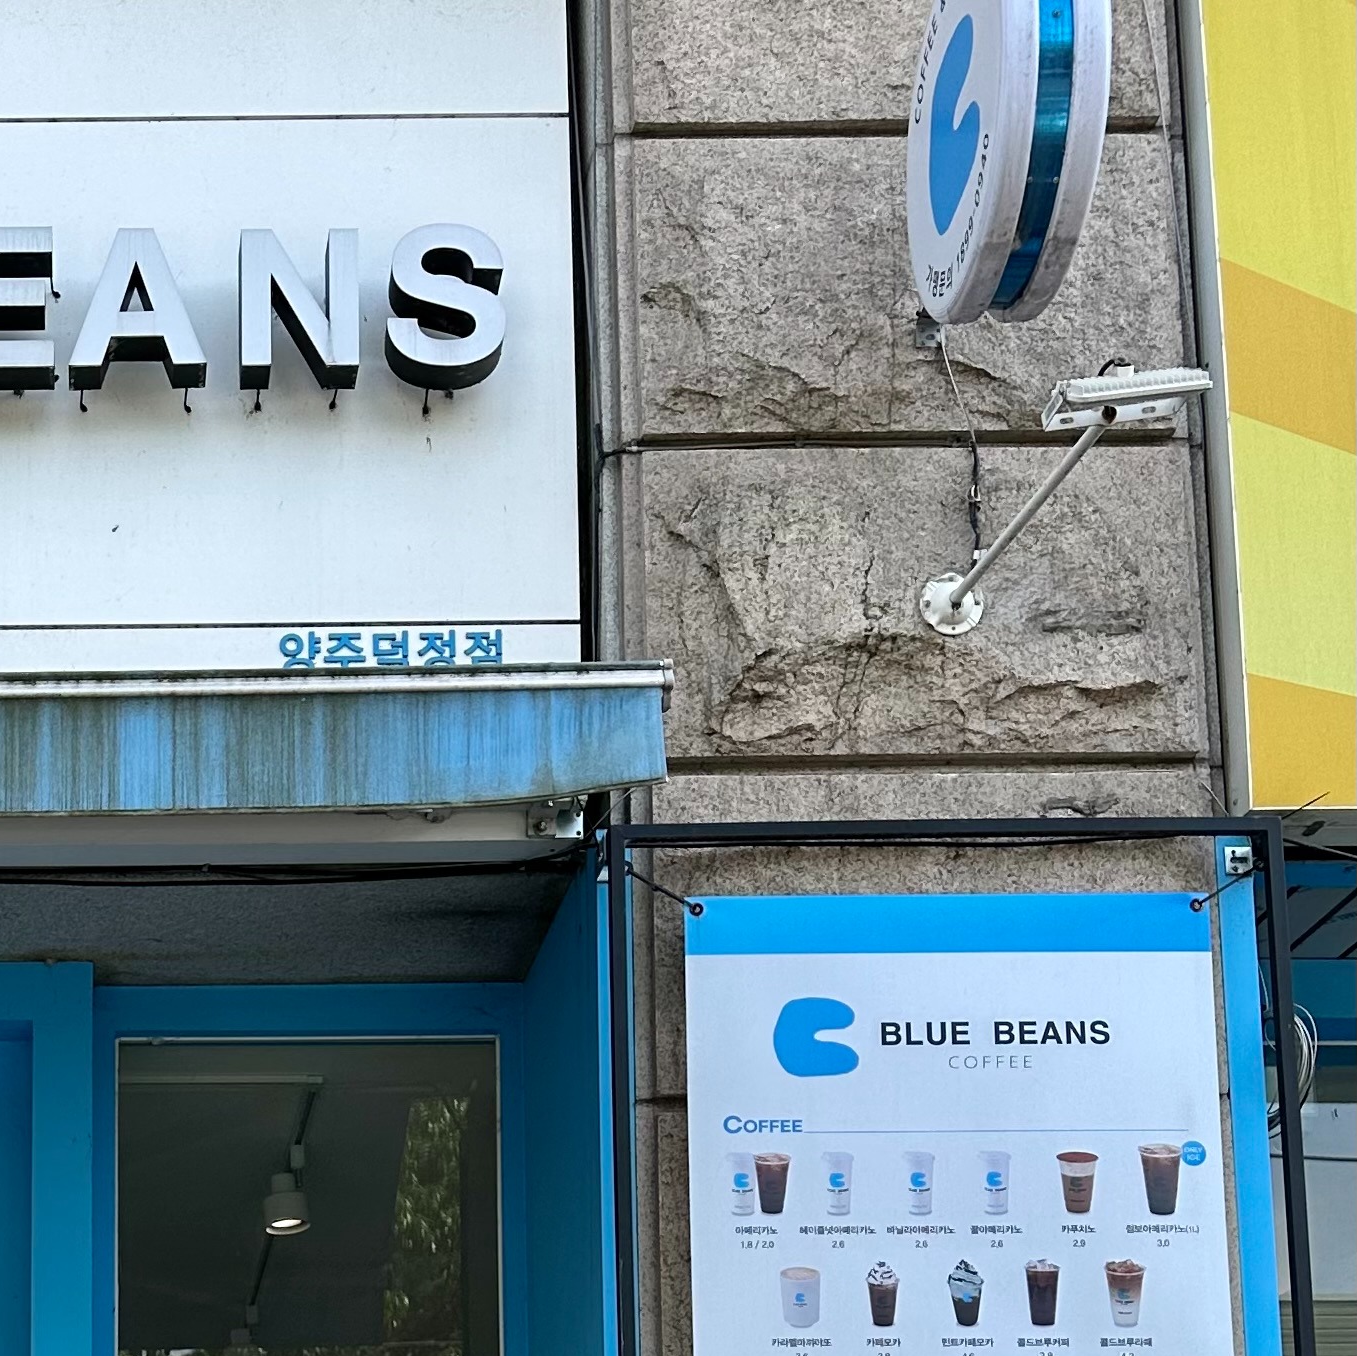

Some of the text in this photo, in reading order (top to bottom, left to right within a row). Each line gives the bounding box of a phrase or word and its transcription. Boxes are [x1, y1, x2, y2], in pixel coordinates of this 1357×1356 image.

[915, 14, 938, 124] COFFEE
[956, 133, 989, 273] 1899-0940
[880, 1020, 1111, 1046] BLUE BEANS
[948, 1055, 1033, 1069] COFFEE
[735, 1226, 778, 1235] 아메리카노
[1061, 1225, 1095, 1234] 카푸치노
[866, 1338, 901, 1347] 카페모카
